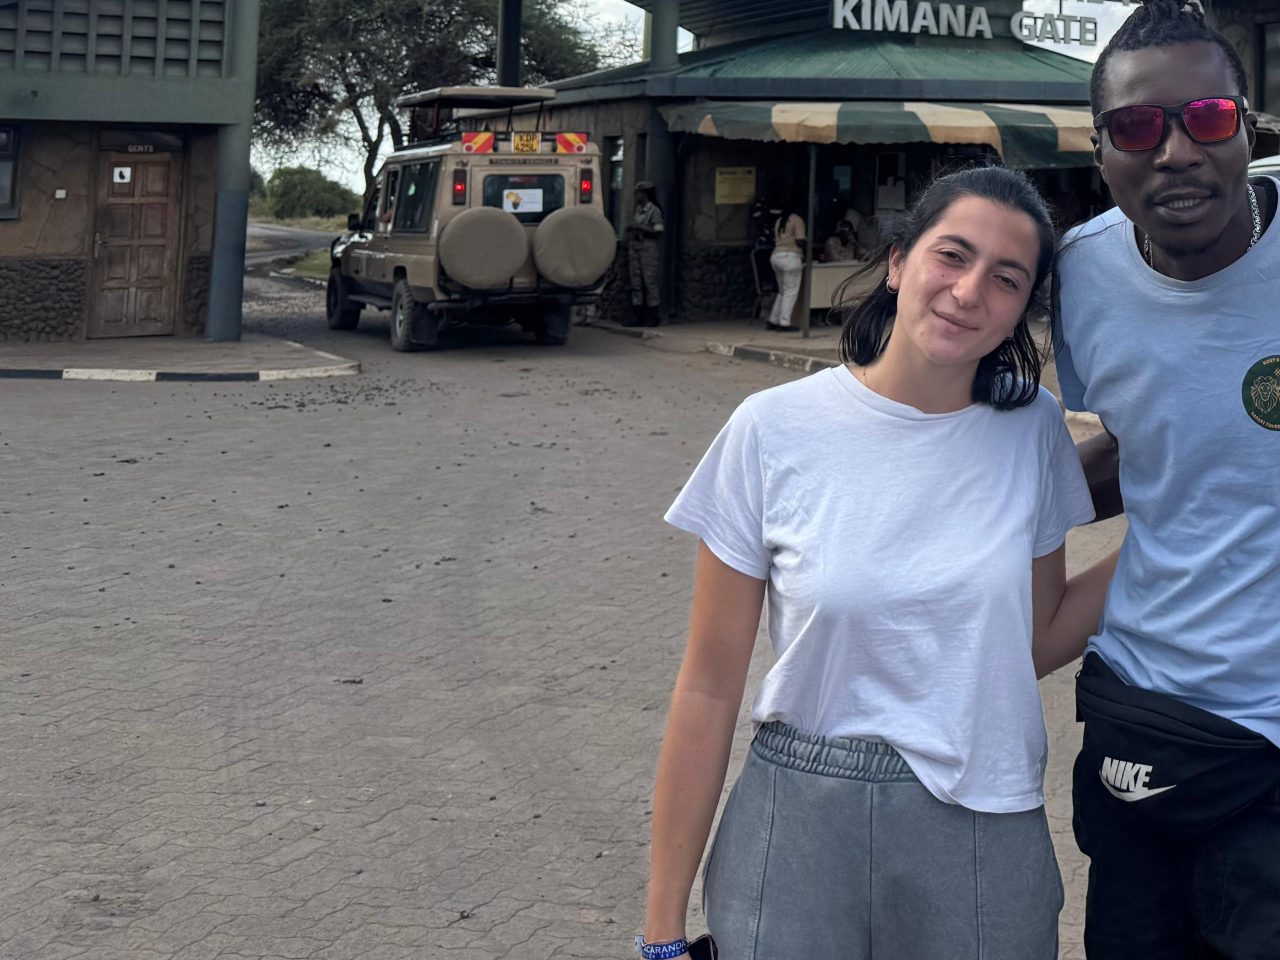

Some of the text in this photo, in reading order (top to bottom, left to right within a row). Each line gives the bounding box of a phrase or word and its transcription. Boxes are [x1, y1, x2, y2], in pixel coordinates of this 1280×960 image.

[1010, 10, 1098, 46] GATE
[1101, 756, 1153, 791] NIKE
[644, 941, 686, 954] ACARANDA
